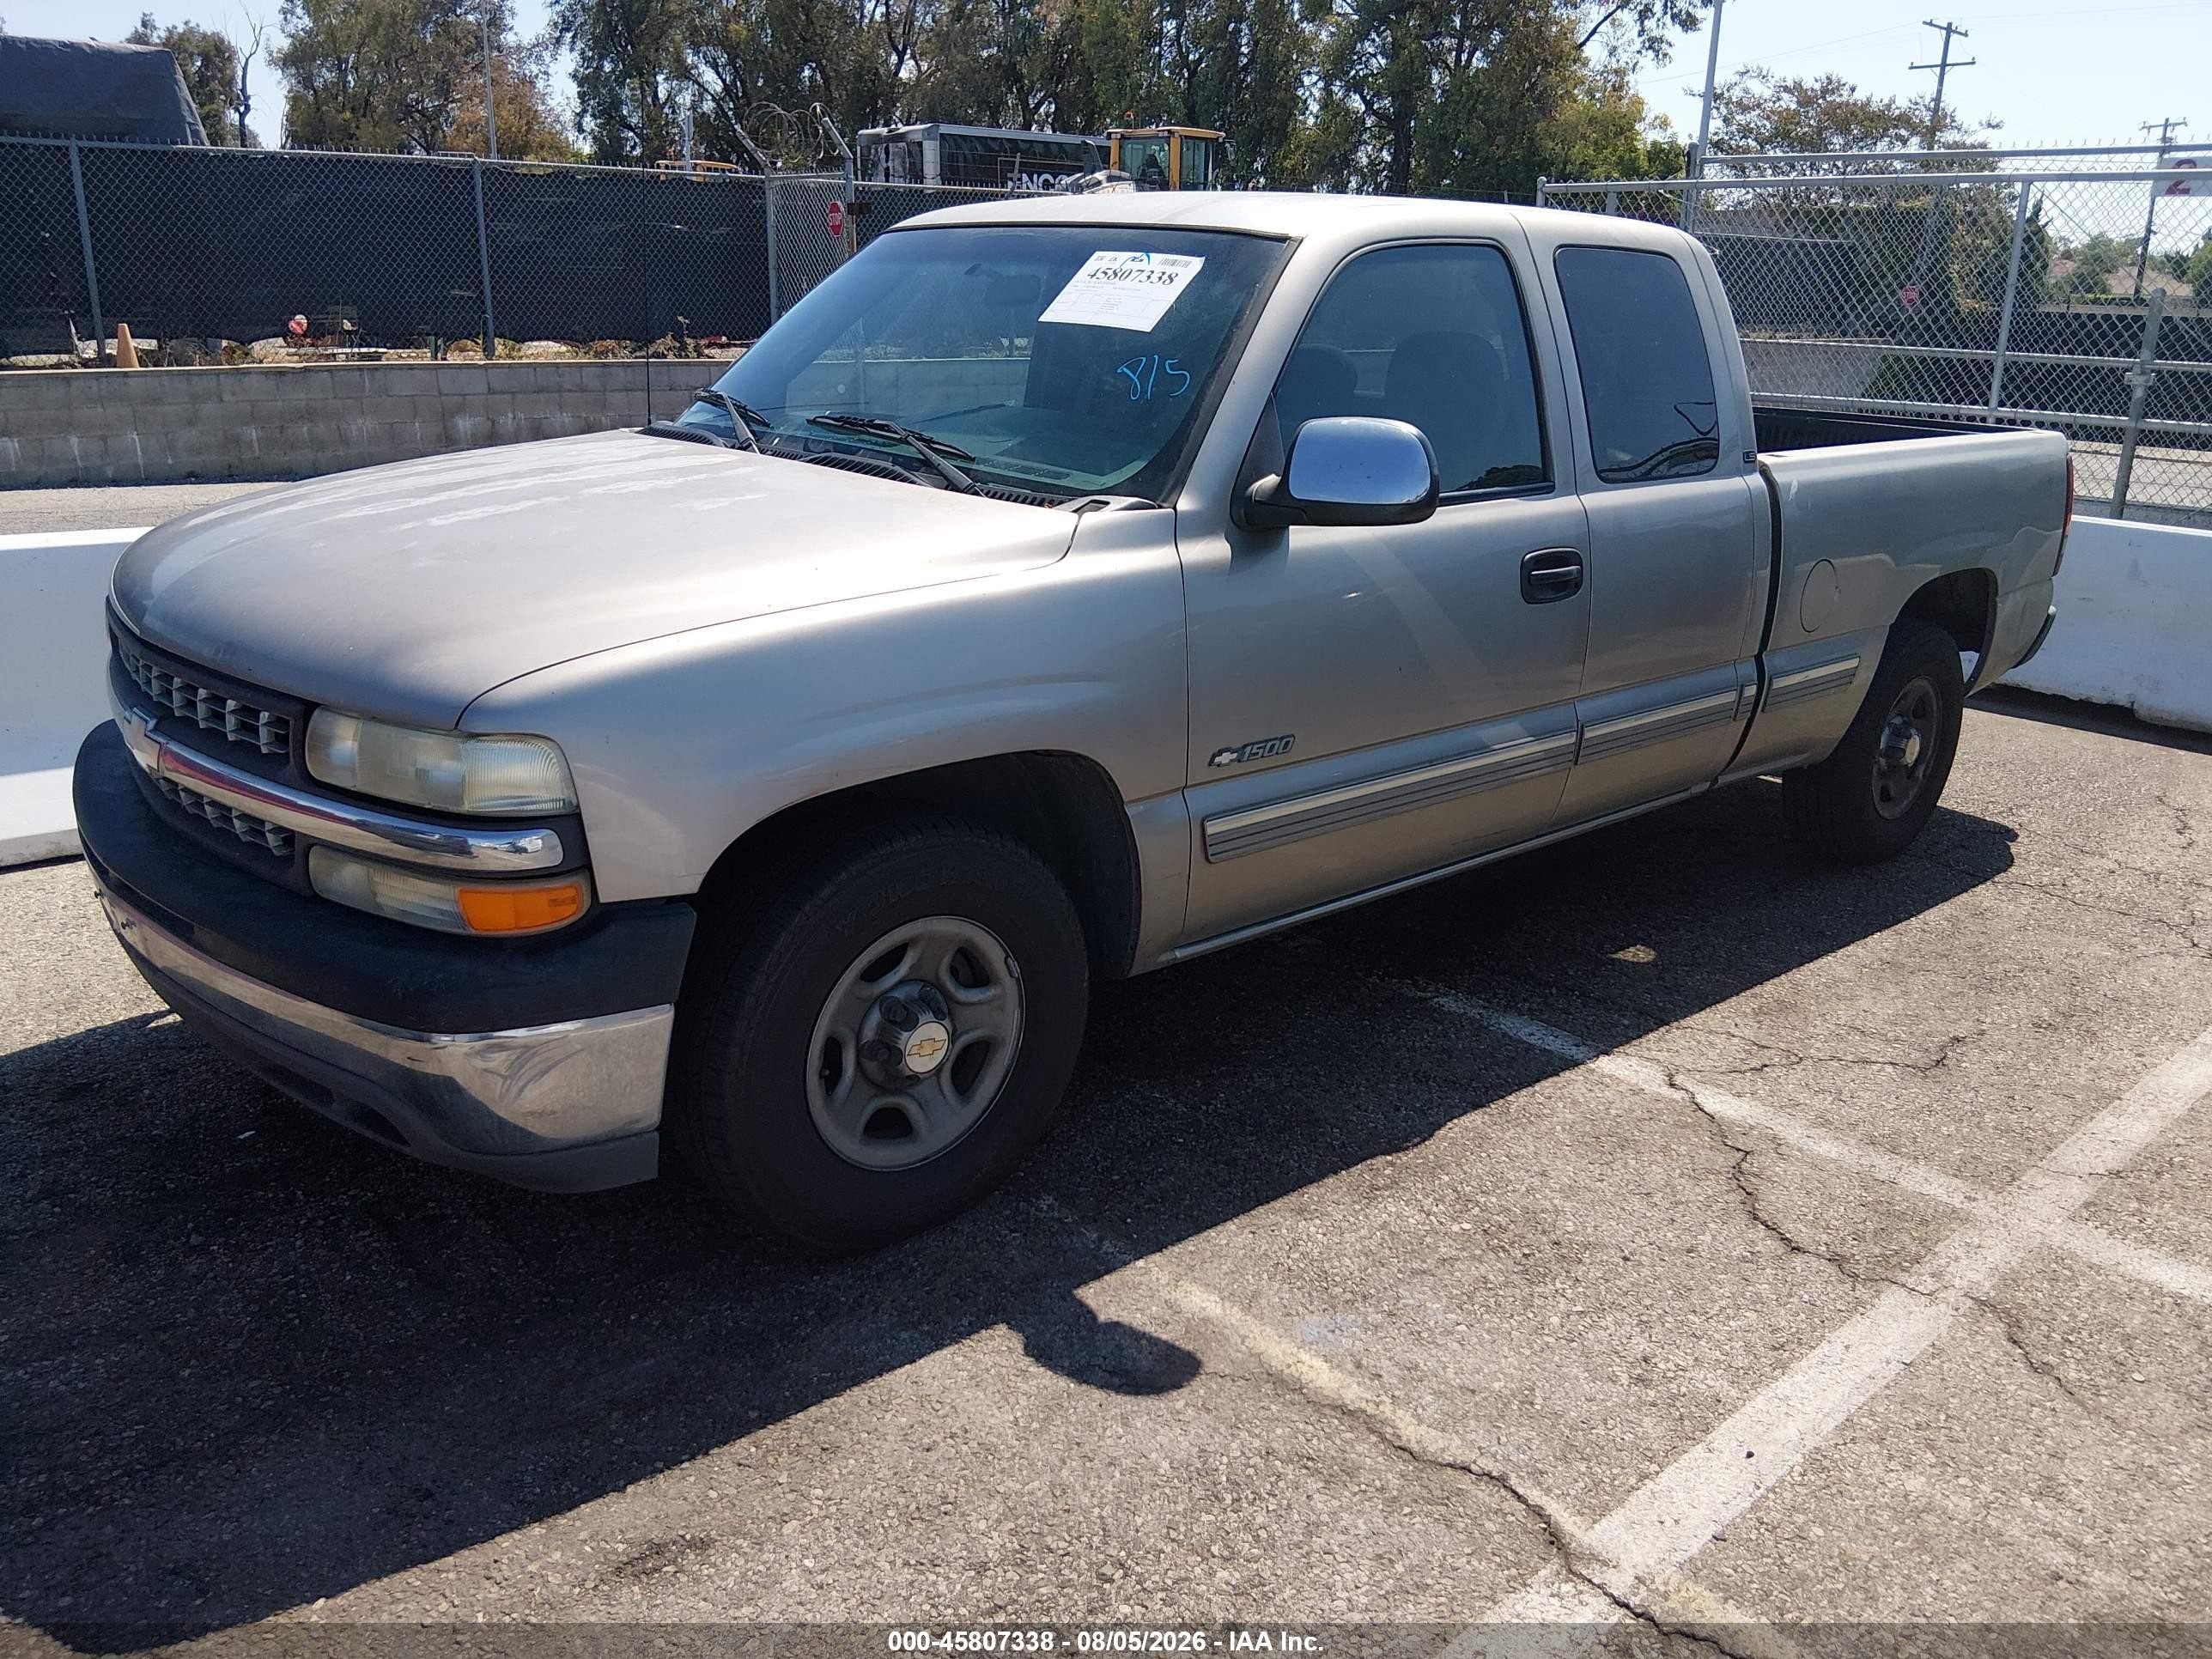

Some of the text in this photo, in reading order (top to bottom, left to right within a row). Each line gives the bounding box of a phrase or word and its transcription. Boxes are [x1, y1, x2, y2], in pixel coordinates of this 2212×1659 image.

[2164, 158, 2197, 195] 2
[829, 212, 842, 226] STOP
[1087, 266, 1179, 286] 45807338
[1242, 735, 1293, 762] 1500
